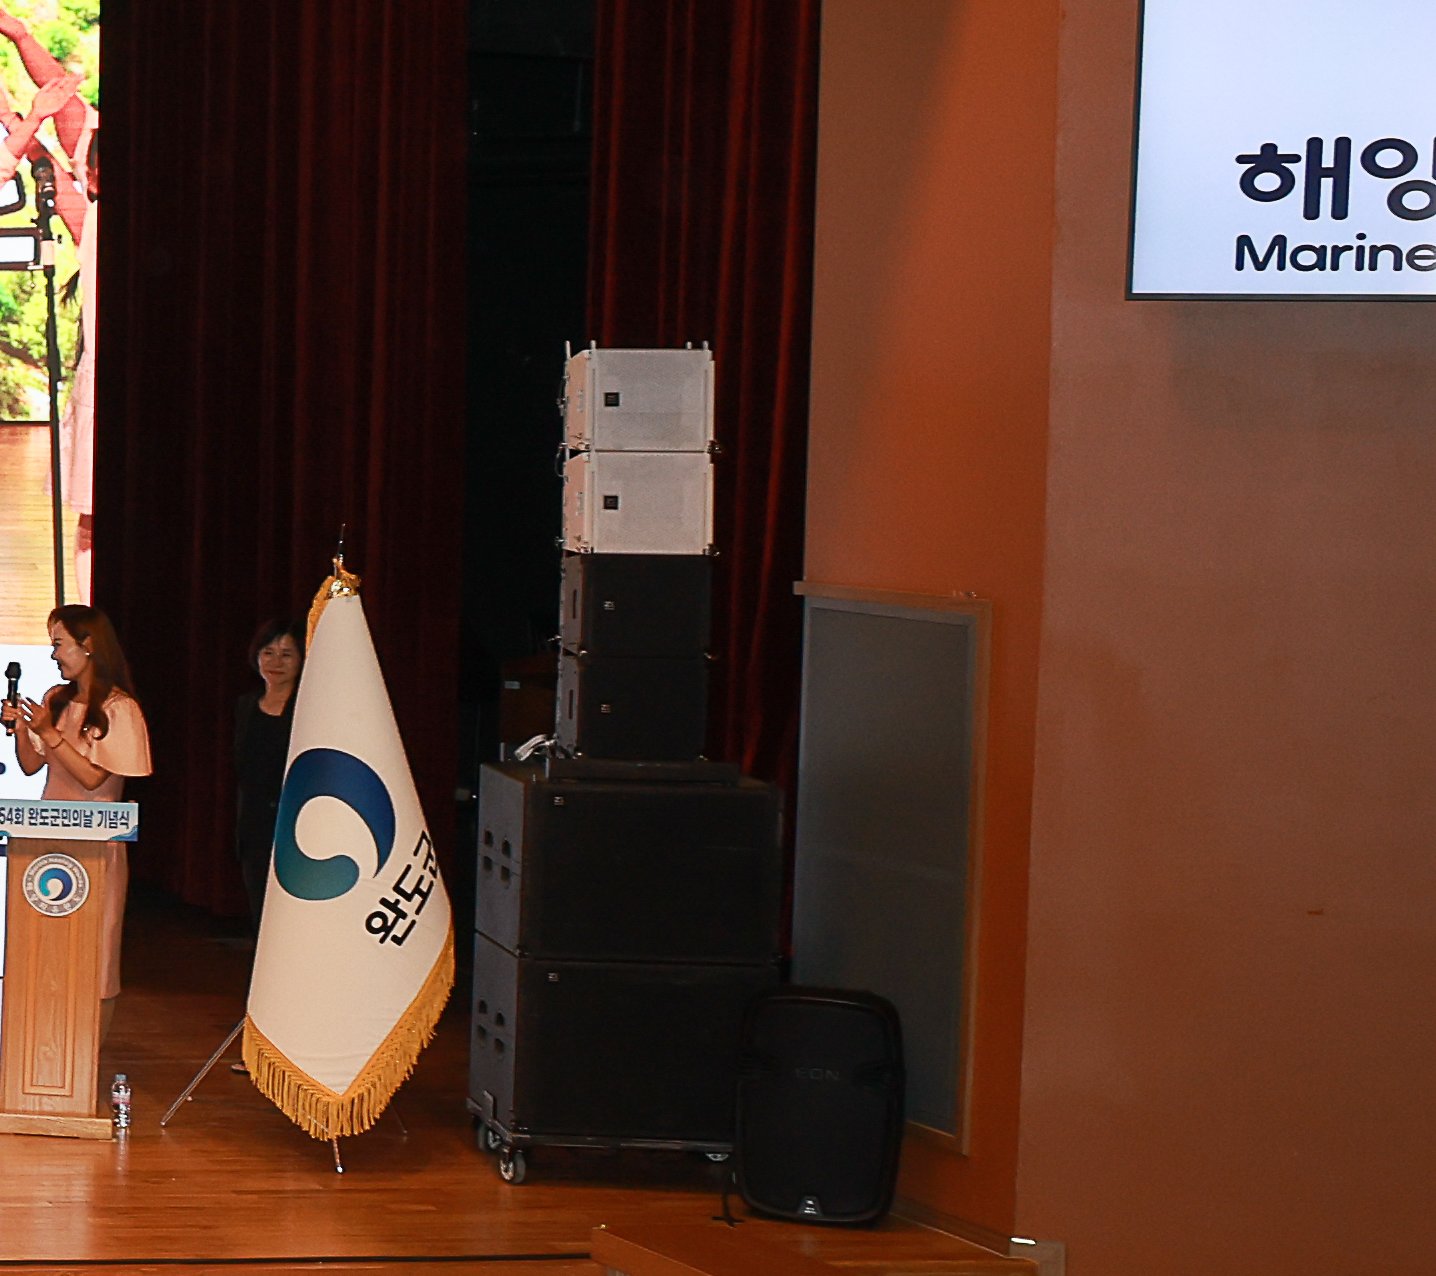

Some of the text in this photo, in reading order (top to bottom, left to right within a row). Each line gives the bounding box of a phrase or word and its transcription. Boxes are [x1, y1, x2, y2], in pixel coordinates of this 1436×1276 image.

[1235, 232, 1436, 272] Marine
[28, 807, 94, 829] 완도군민의날
[97, 810, 130, 830] 기념식
